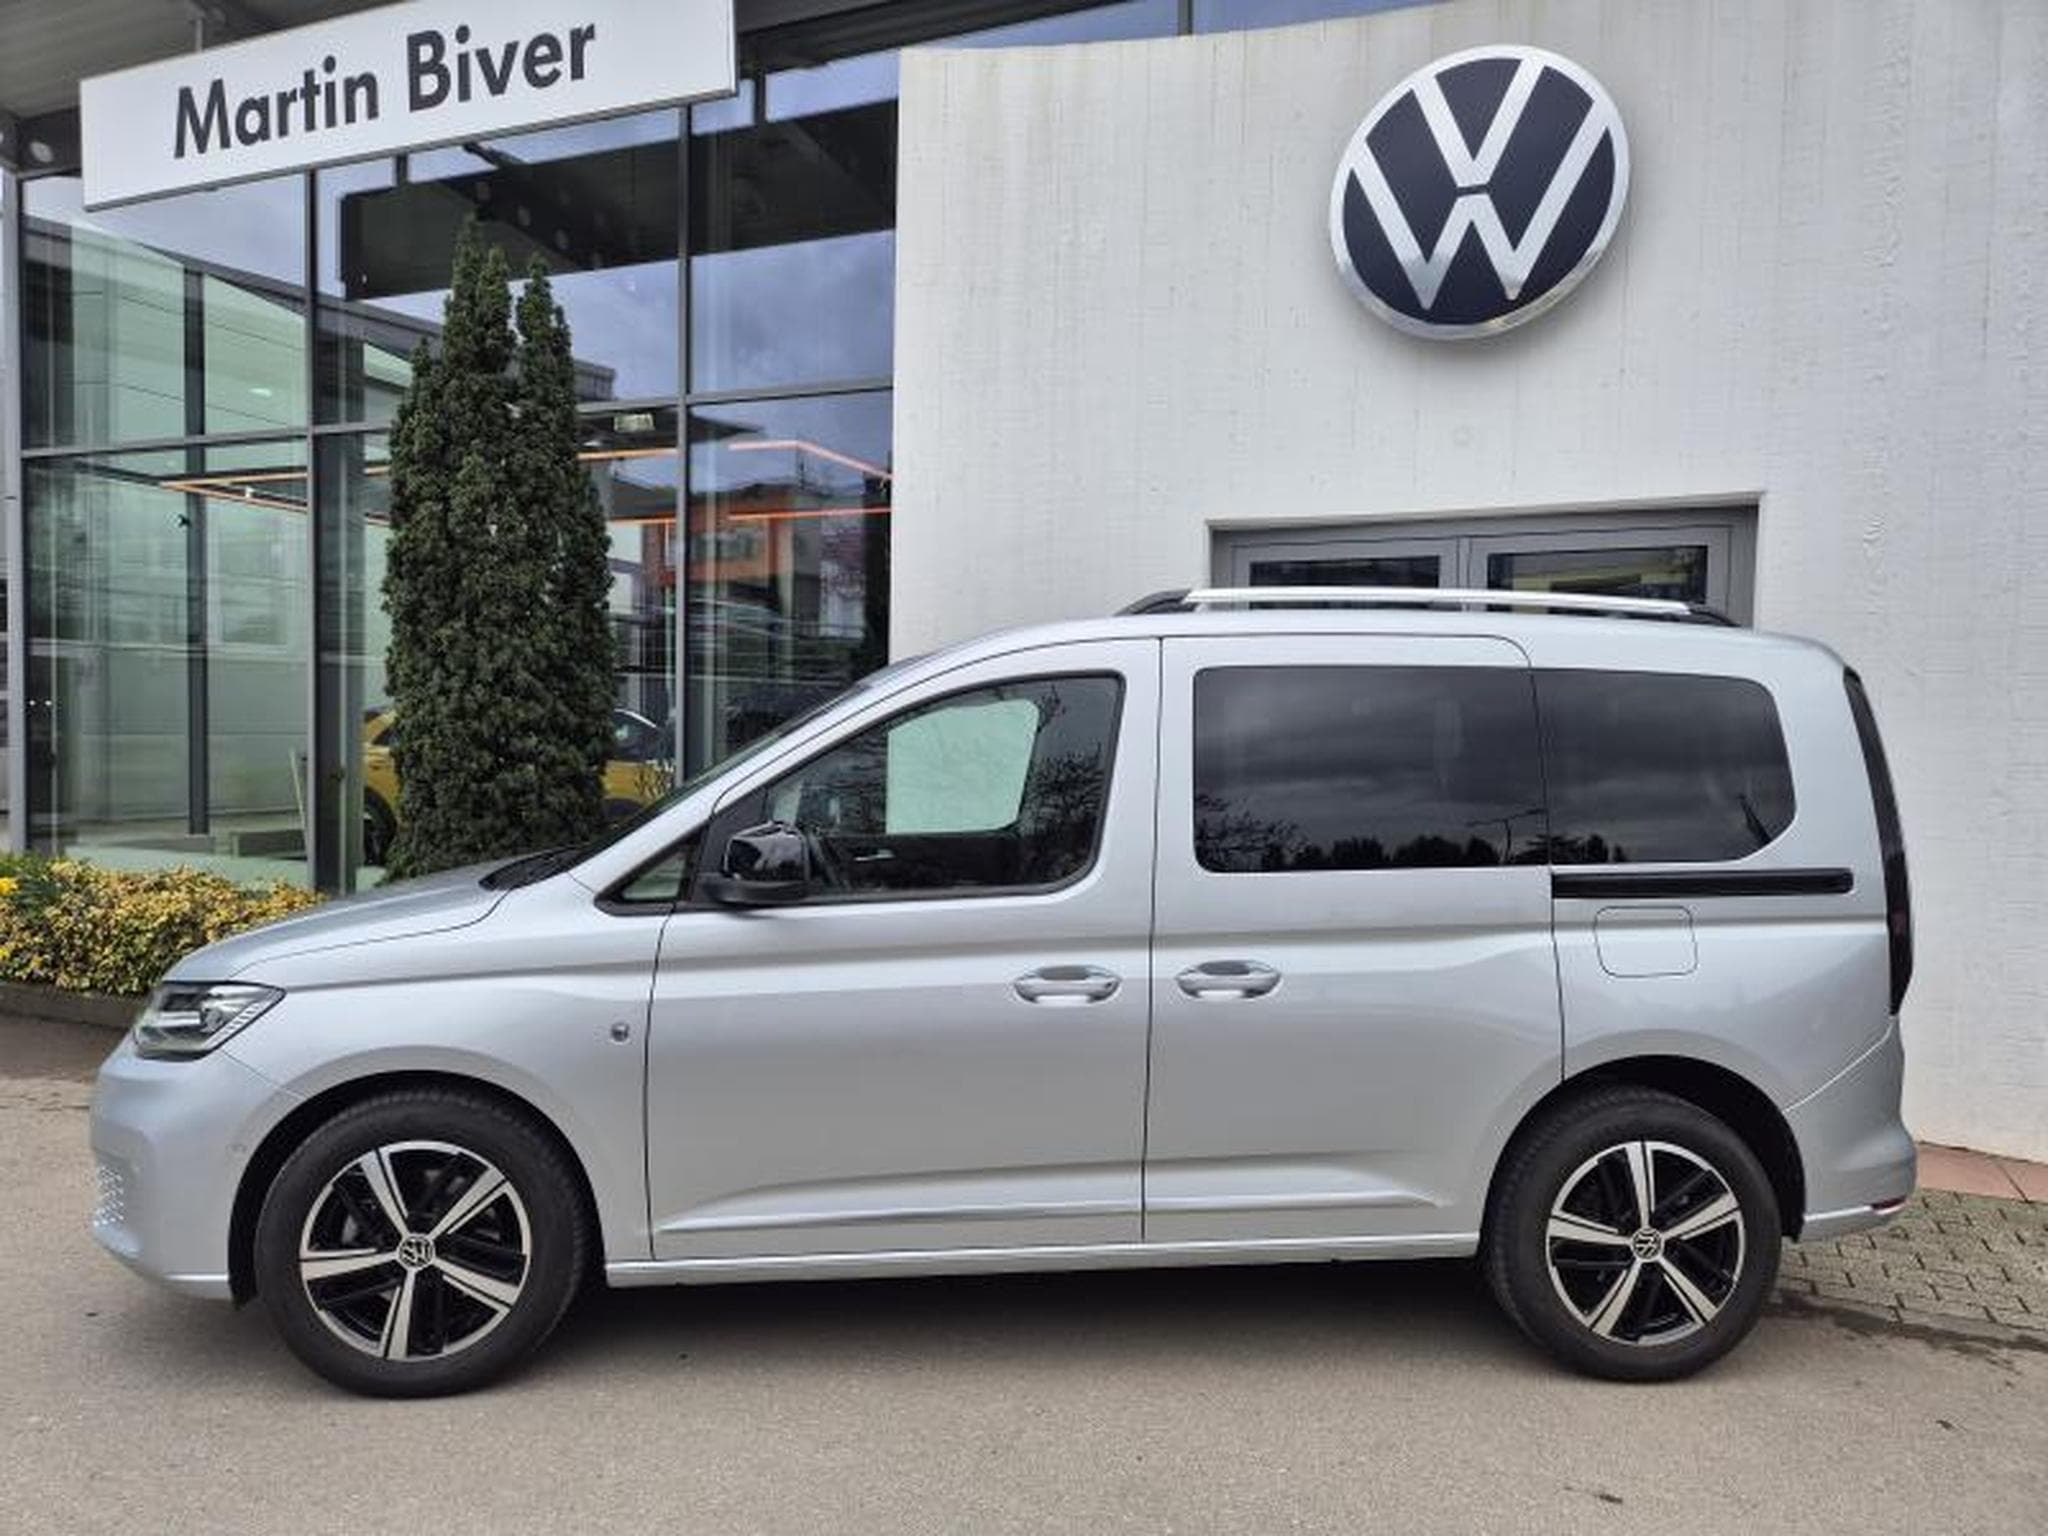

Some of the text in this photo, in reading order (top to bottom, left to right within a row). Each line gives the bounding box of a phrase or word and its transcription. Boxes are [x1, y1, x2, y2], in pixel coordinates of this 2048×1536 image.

[173, 23, 596, 160] Martin Biver
[1346, 55, 1612, 312] VW
